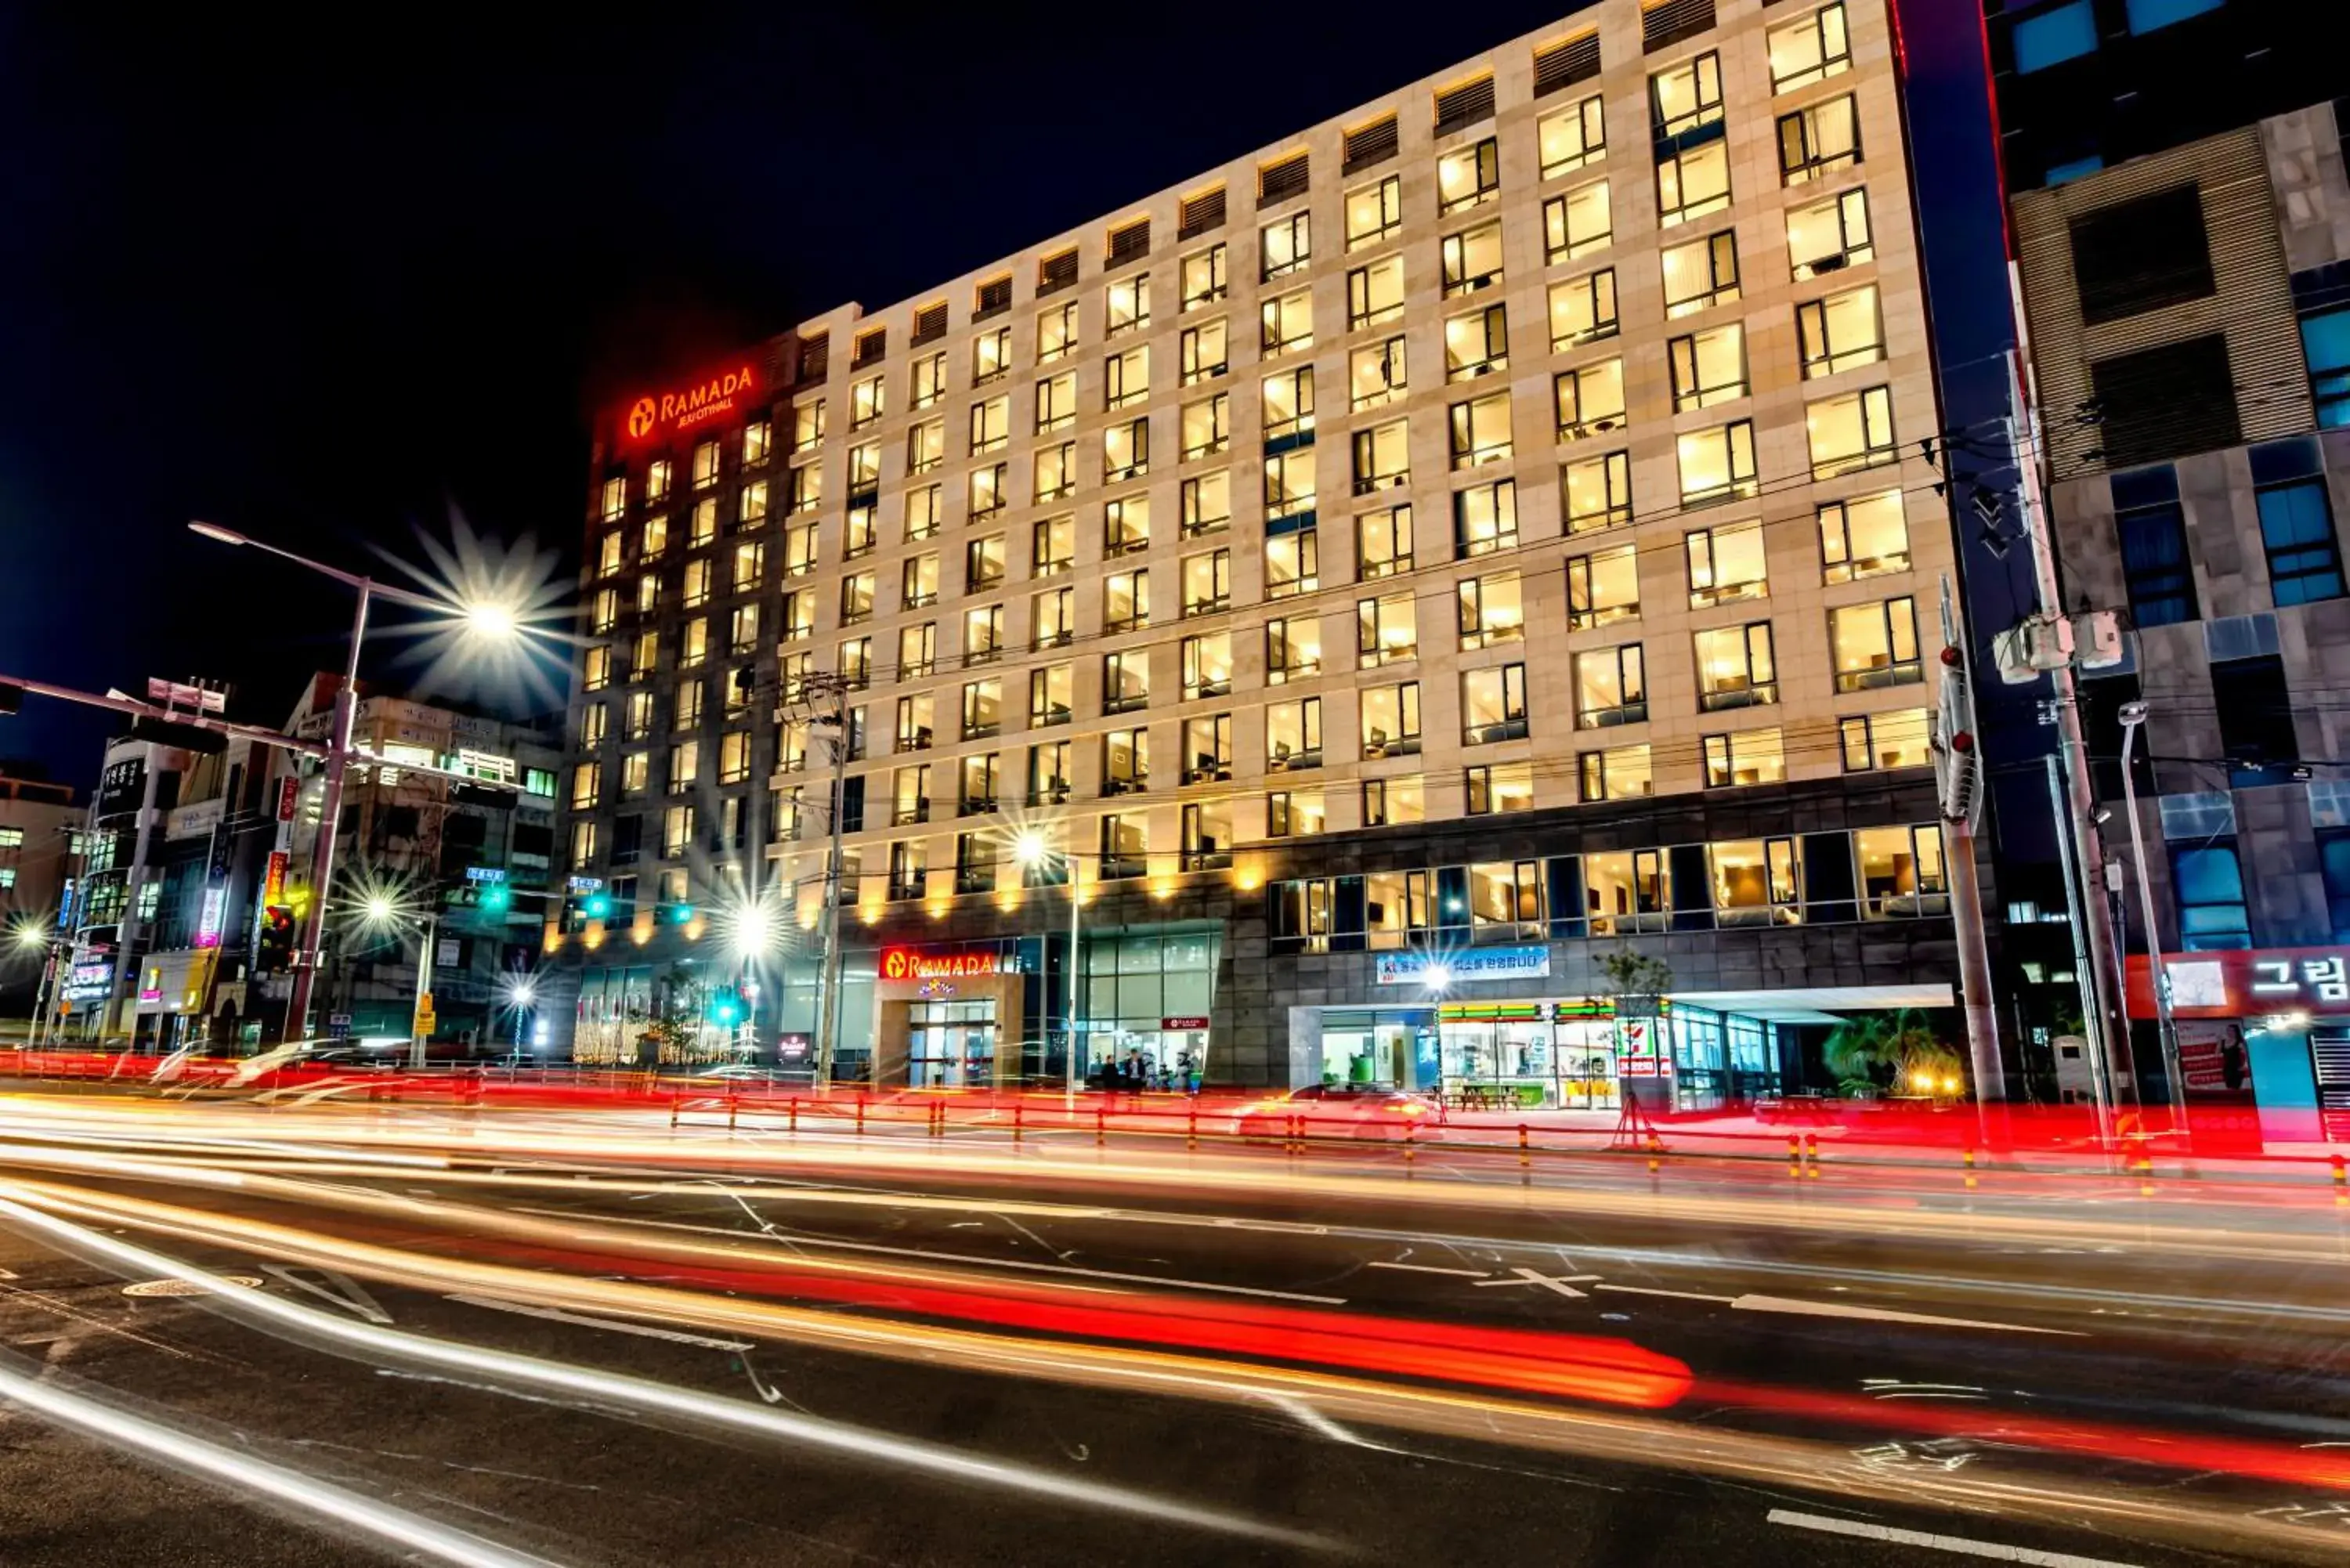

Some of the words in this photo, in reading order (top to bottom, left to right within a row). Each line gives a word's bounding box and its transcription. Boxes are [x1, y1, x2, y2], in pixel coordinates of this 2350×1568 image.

[661, 367, 752, 422] RAMADA
[909, 956, 993, 977] RAMADA
[1486, 954, 1538, 970] 환영합니다
[2253, 957, 2349, 1001] 그림
